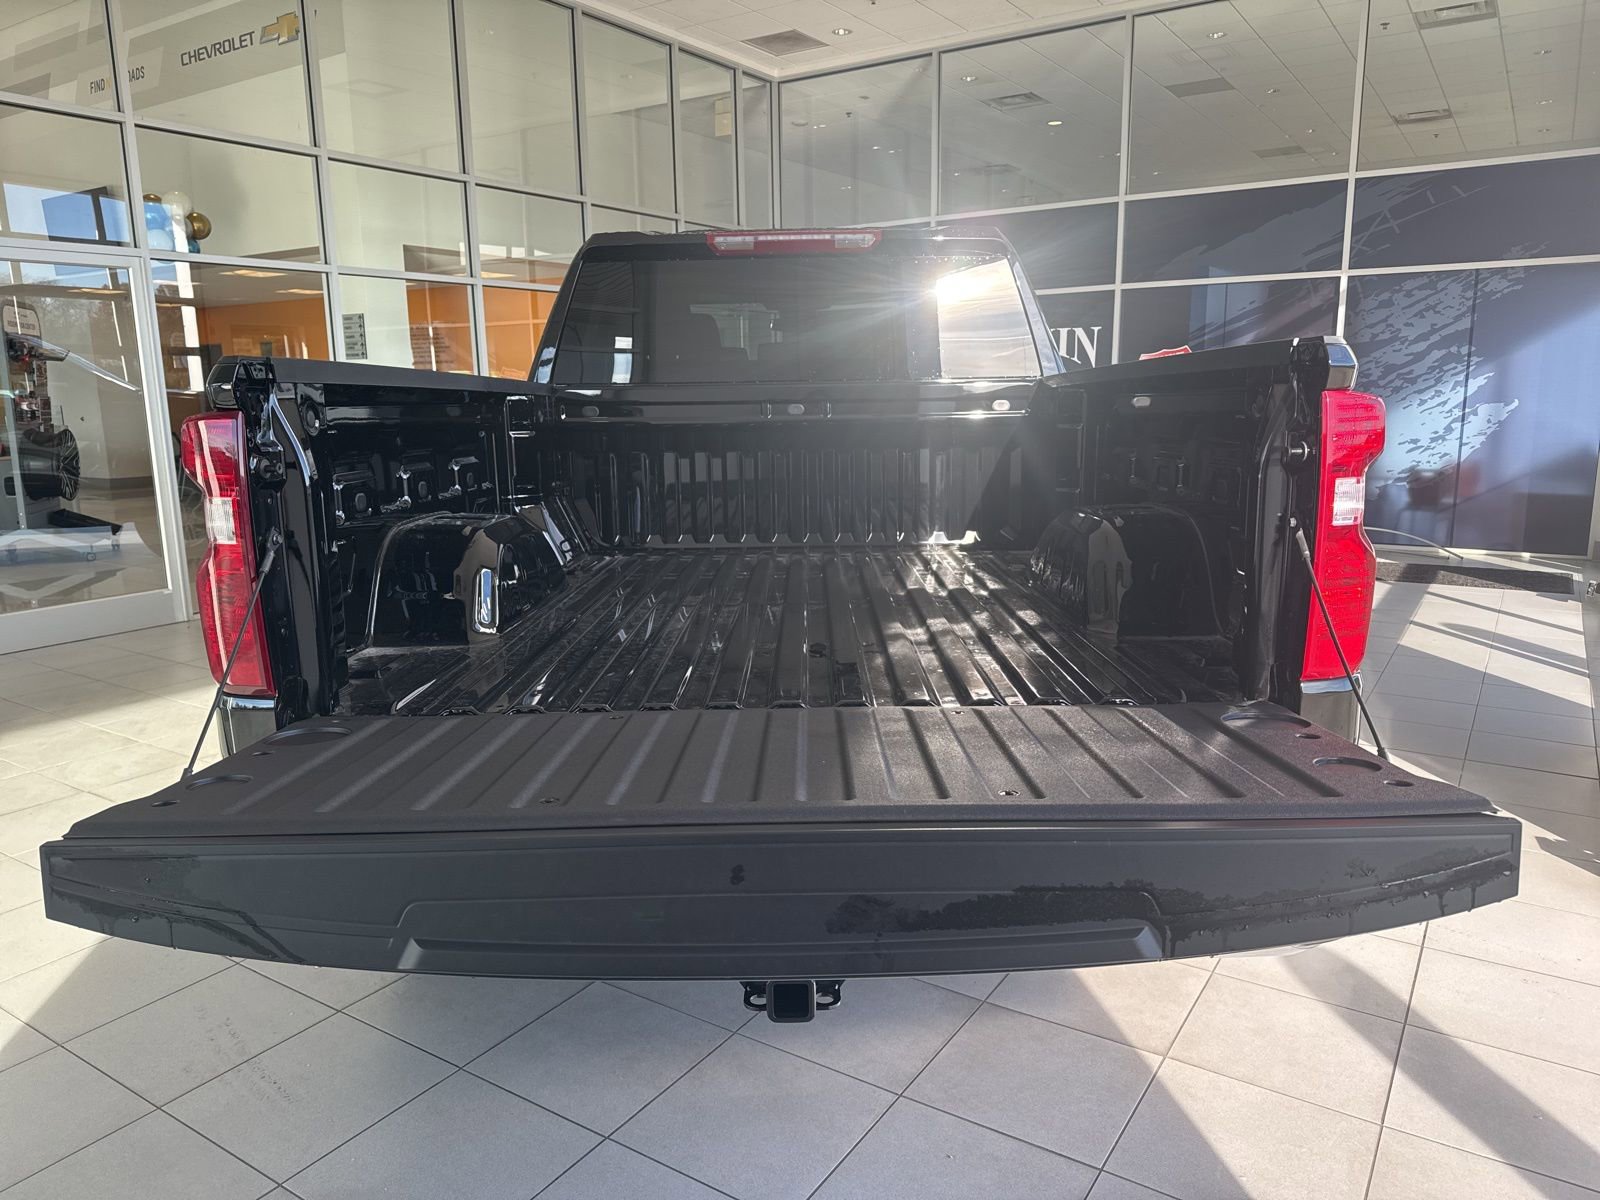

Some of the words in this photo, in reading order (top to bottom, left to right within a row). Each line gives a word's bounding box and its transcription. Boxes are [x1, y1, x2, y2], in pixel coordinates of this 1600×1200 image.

[180, 31, 255, 66] CHEVROLET
[90, 78, 105, 94] FIND
[1051, 326, 1102, 368] IN
